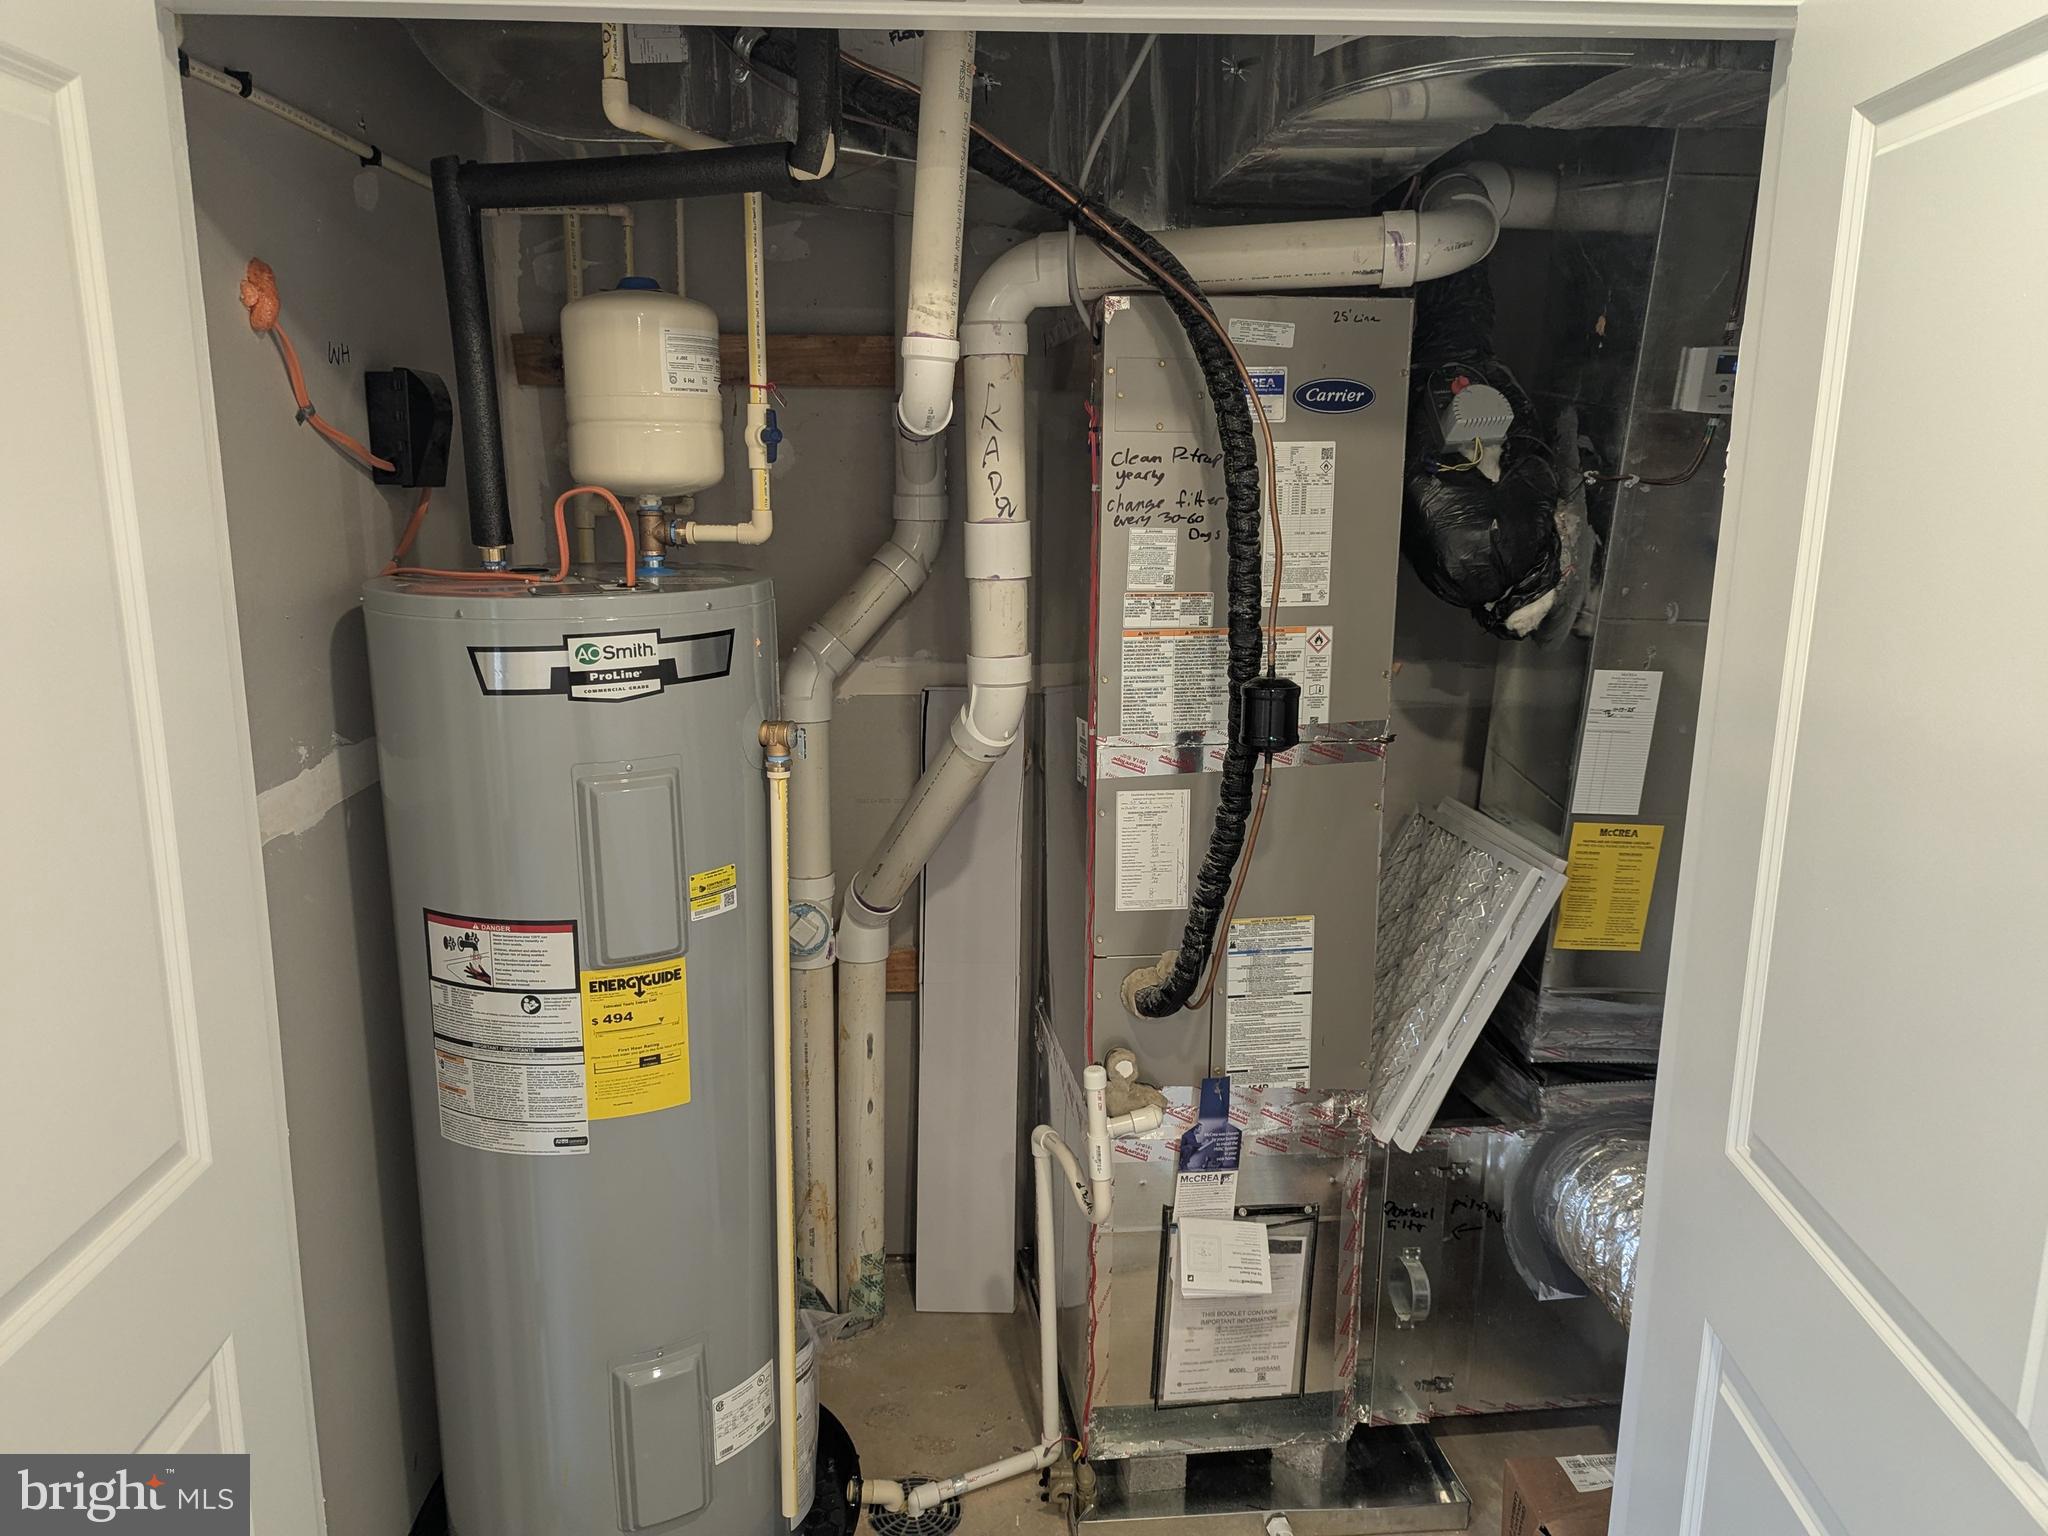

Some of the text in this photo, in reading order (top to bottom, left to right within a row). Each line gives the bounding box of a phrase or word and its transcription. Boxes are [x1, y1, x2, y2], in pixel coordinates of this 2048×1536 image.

[328, 341, 350, 366] WH
[1305, 387, 1365, 402] Carrier
[1111, 448, 1162, 467] Clean
[1113, 512, 1204, 527] every 30-60
[602, 642, 654, 661] Smith
[589, 669, 641, 682] ProLine
[583, 686, 626, 694] COMMERCIAL
[1599, 828, 1638, 838] McCREA
[481, 924, 511, 932] DANGER
[589, 968, 682, 995] ENERGYGUIDE
[591, 1011, 634, 1026] $ 494
[1180, 1174, 1219, 1183] McCREA
[1247, 1308, 1278, 1316] CONTAINS
[1200, 1316, 1278, 1326] IMPORTANT INFORMATION
